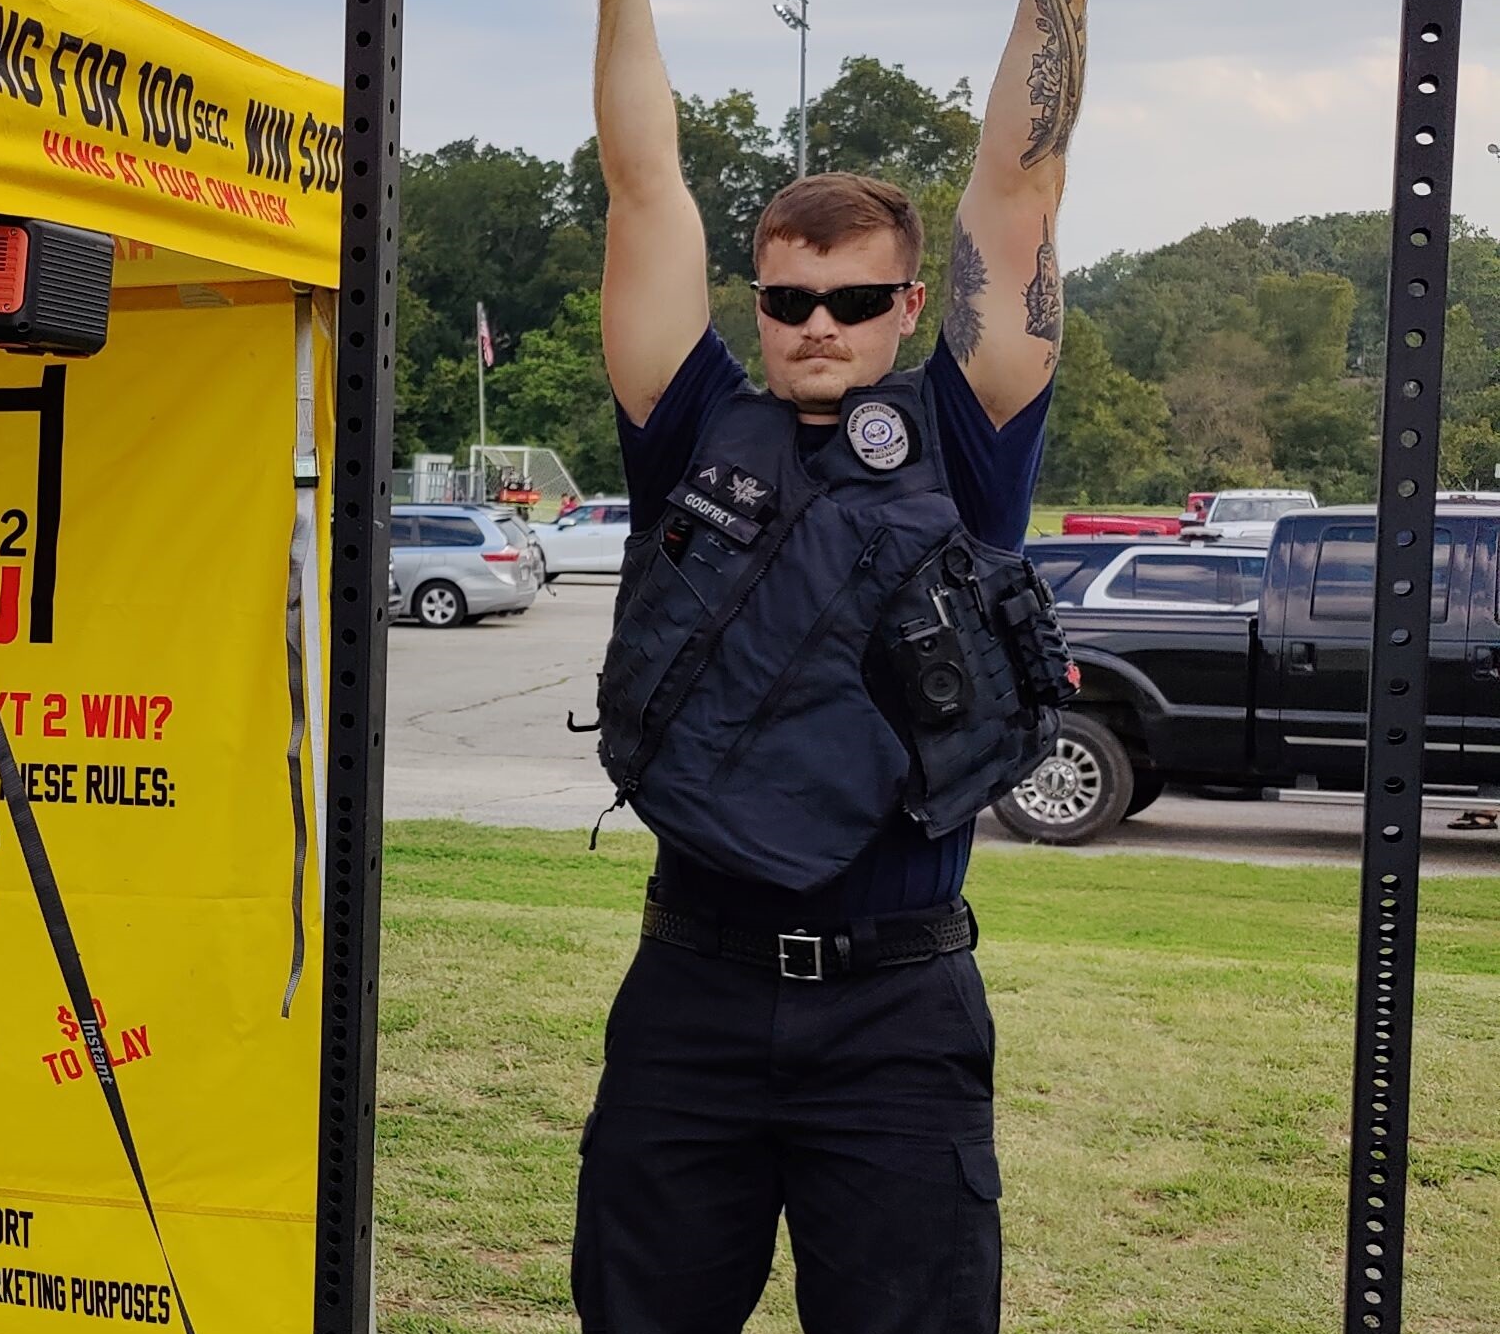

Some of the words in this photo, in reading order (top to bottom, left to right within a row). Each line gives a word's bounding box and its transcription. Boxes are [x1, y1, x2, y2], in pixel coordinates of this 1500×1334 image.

[50, 32, 129, 137] FOR
[138, 61, 194, 155] 100
[193, 99, 235, 150] SEC.
[245, 98, 295, 184] WIN
[299, 112, 344, 194] $10
[43, 129, 116, 181] HANG
[116, 152, 145, 188] AT
[144, 158, 209, 206] YOUR
[205, 177, 253, 218] OWN
[250, 189, 296, 229] RISK
[0, 509, 28, 557] 2
[684, 493, 737, 527] GODFREY
[43, 693, 67, 737] 2
[81, 694, 173, 741] WIN?
[85, 764, 176, 808] RULES:
[41, 1048, 84, 1085] TO
[81, 1019, 114, 1086] Instant
[71, 1276, 171, 1325] PURPOSES
